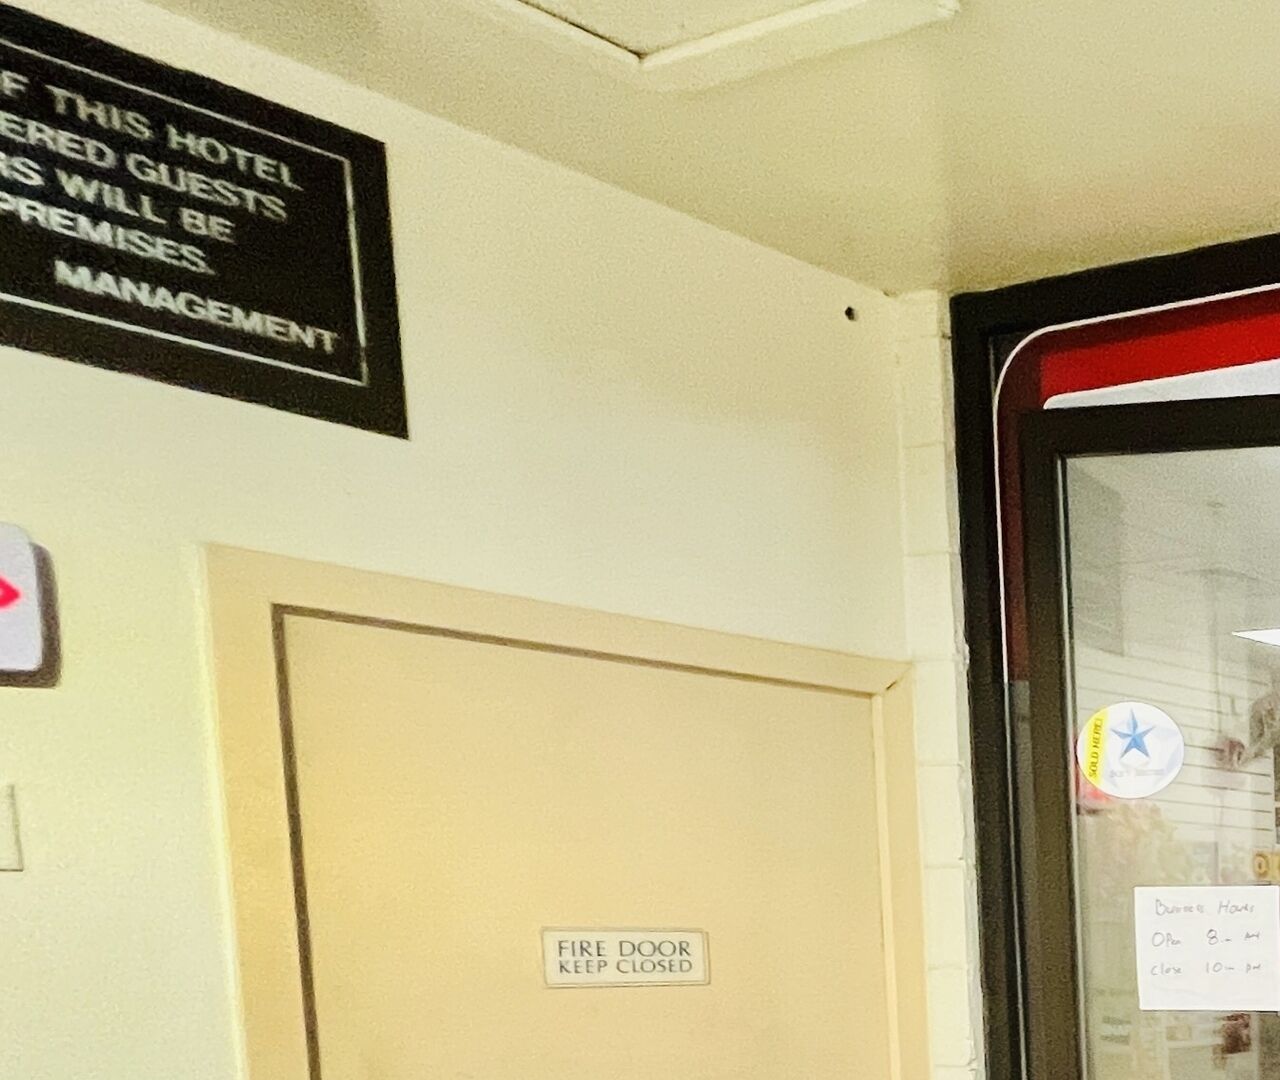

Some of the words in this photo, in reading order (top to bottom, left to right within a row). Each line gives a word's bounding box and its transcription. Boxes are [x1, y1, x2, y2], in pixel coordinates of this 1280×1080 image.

[45, 84, 155, 141] THIS
[166, 122, 304, 192] HOTEL
[54, 167, 169, 225] WILL
[179, 207, 236, 244] BE
[125, 152, 288, 222] GUESTS
[53, 259, 340, 356] MANAGEMENT
[558, 940, 607, 958] FIRE
[618, 940, 692, 958] DOOR
[559, 959, 608, 974] KEEP
[616, 958, 693, 974] CLOSED
